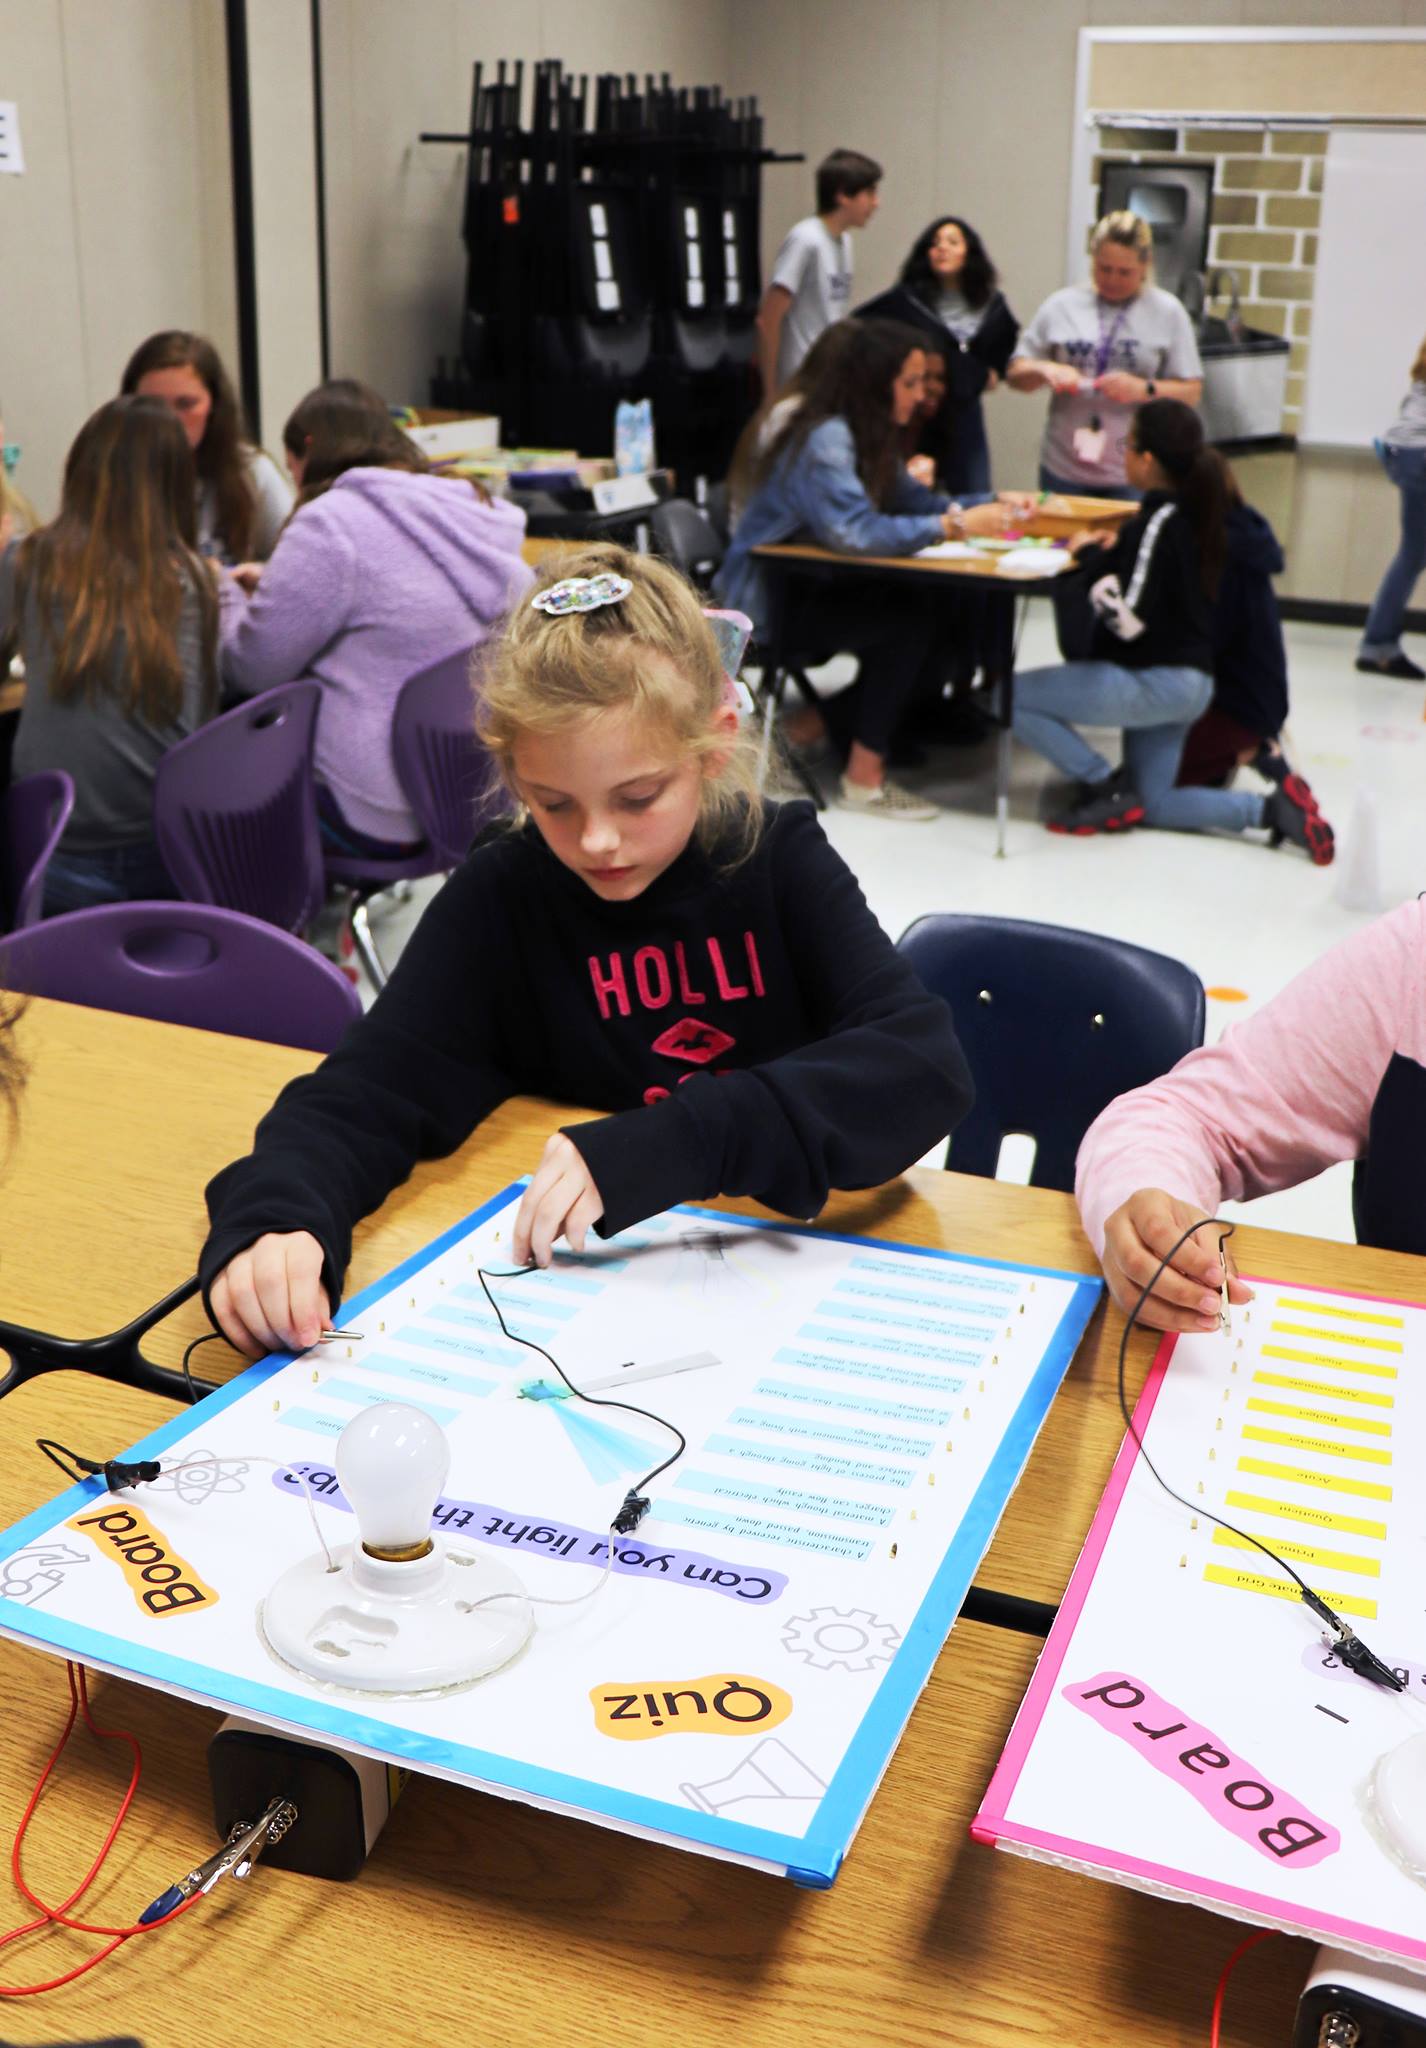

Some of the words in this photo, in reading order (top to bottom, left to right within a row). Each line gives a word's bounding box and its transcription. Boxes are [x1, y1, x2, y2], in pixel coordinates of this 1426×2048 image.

[588, 931, 766, 1020] HOLLI
[1296, 1410, 1338, 1422] Budget
[1288, 1437, 1344, 1452] Perimeter
[284, 1467, 340, 1494] lb?
[1296, 1473, 1331, 1484] Acute
[714, 1488, 757, 1499] electrical
[778, 1489, 802, 1497] easily
[763, 1497, 789, 1505] which
[796, 1503, 828, 1513] though
[856, 1504, 890, 1513] charges
[1279, 1506, 1332, 1522] Quotient
[433, 1504, 473, 1528] th
[684, 1517, 718, 1527] genetic
[736, 1517, 761, 1526] down
[833, 1511, 874, 1520] material
[767, 1523, 800, 1532] passed
[483, 1518, 578, 1555] light
[740, 1529, 780, 1540] received
[786, 1538, 851, 1554] characteristic
[1277, 1545, 1314, 1558] Prime
[78, 1511, 206, 1614] Board
[589, 1543, 674, 1572] you
[684, 1564, 771, 1598] Can
[1236, 1576, 1264, 1588] Grid
[1268, 1582, 1344, 1606] Cooinate
[604, 1682, 772, 1726] Quiz
[1080, 1673, 1327, 1858] Board
